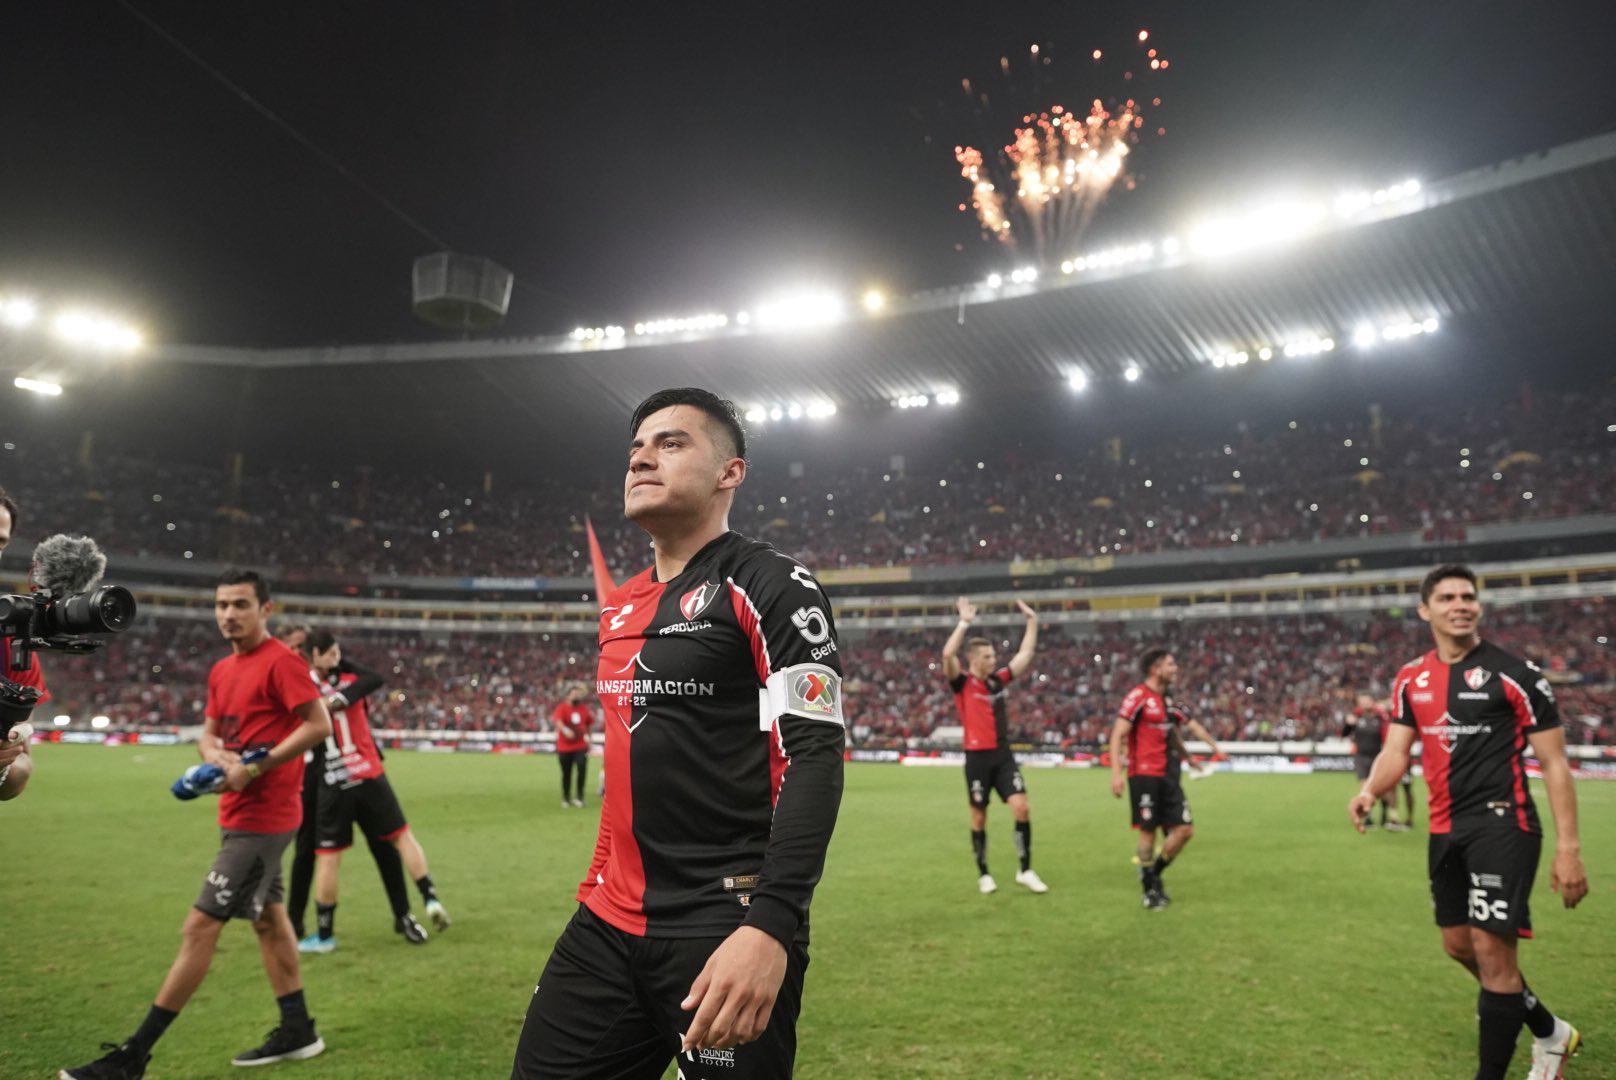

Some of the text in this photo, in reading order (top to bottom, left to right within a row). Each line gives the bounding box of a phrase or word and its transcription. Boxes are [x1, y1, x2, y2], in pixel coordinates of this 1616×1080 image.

[659, 620, 712, 636] PERDURA
[617, 696, 647, 706] 21-22
[699, 1048, 735, 1059] COUNTRY
